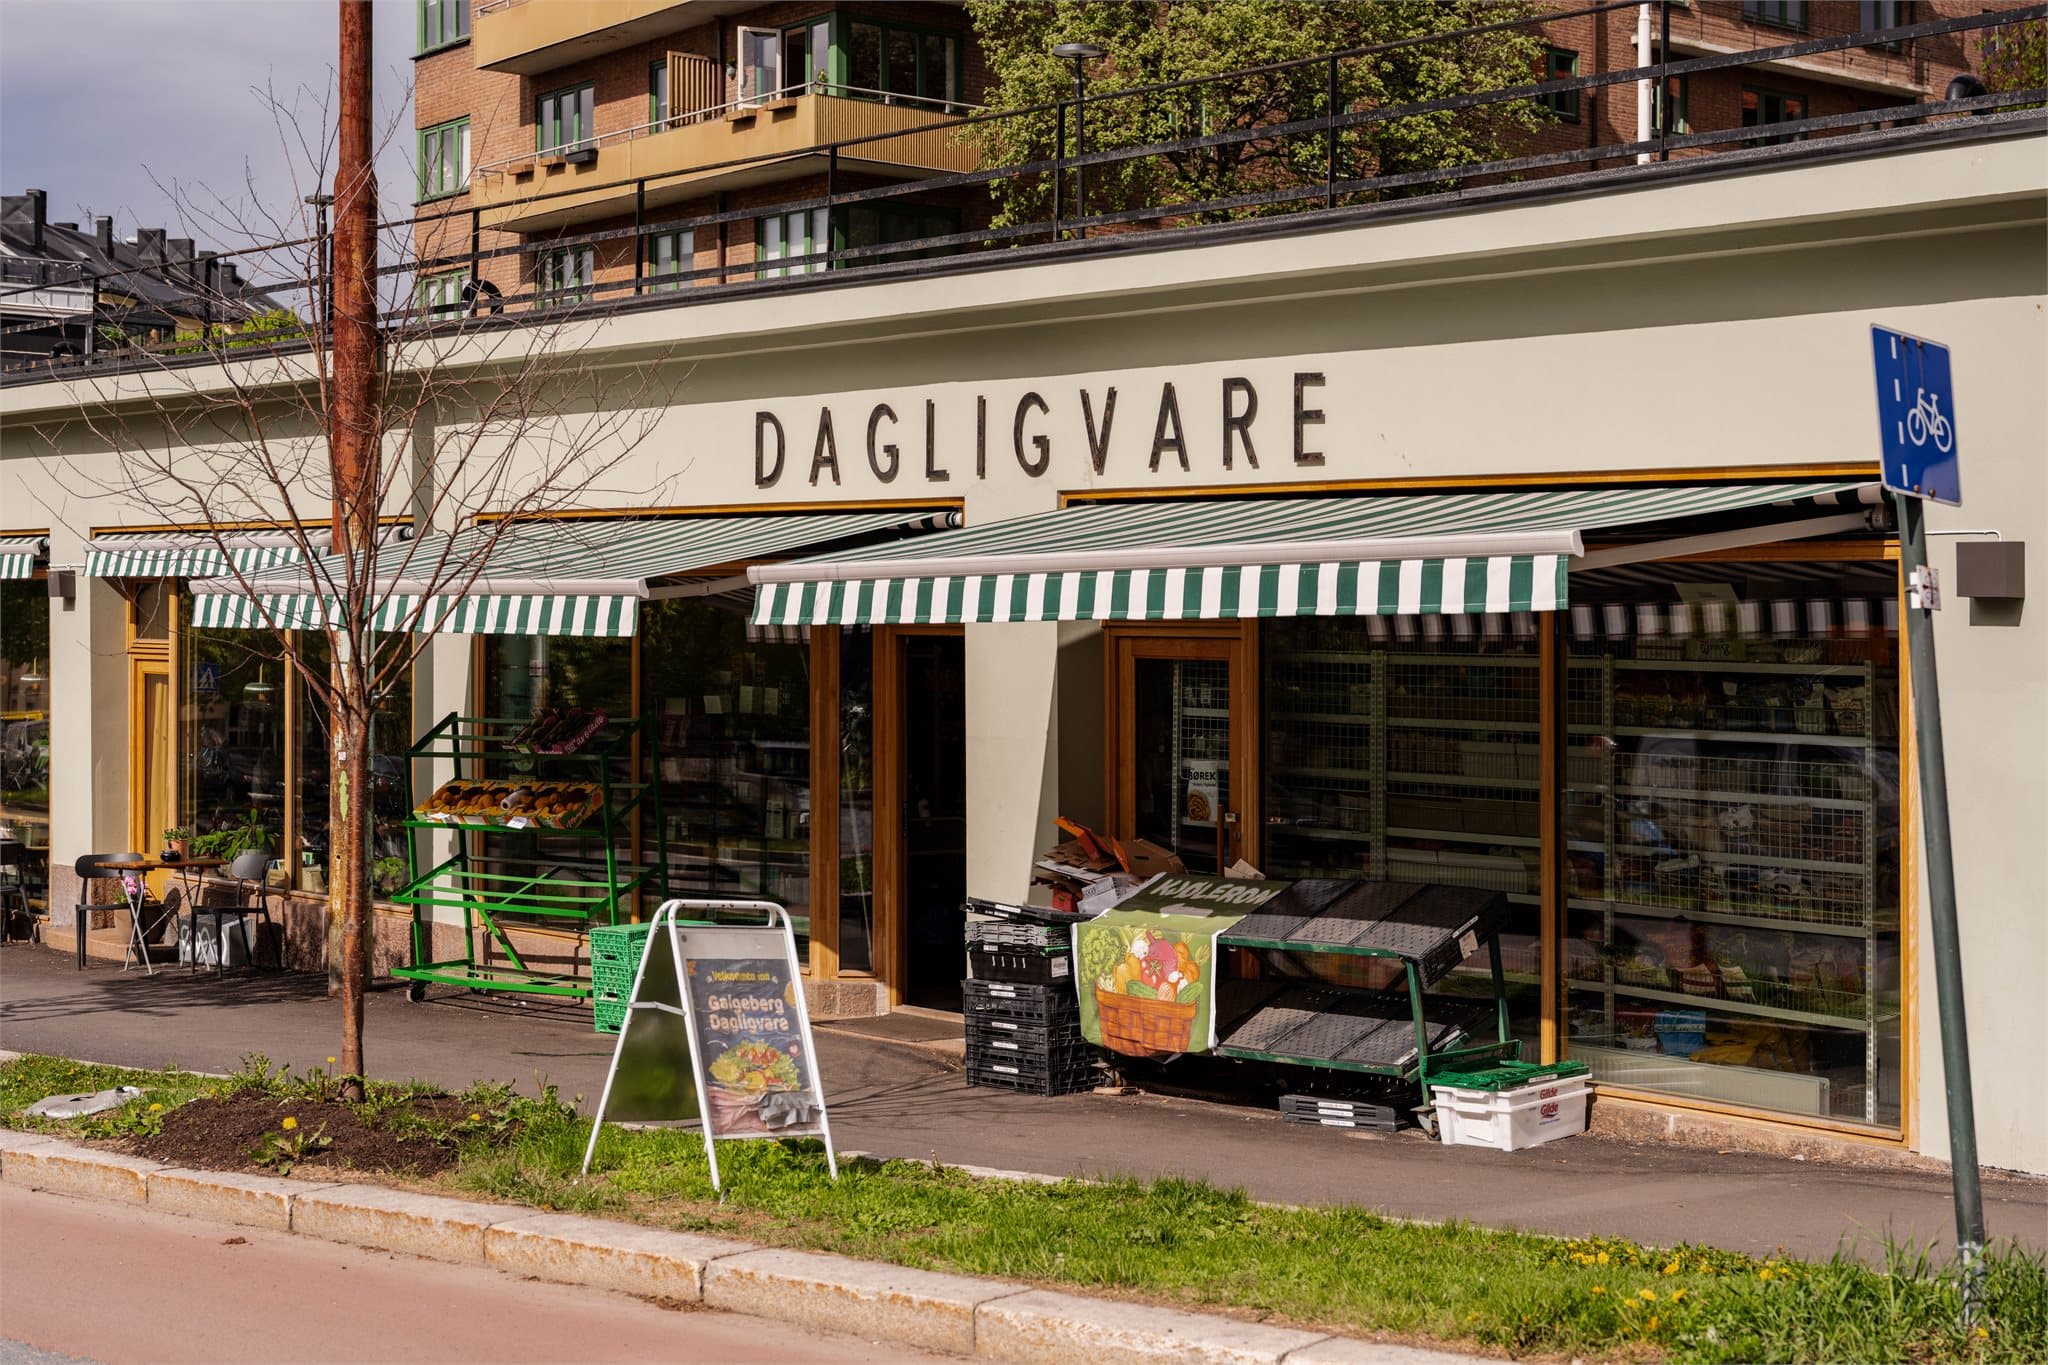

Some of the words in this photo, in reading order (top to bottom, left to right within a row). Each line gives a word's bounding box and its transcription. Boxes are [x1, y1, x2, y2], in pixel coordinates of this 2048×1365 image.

[755, 372, 1326, 487] DAGLIGVARE
[708, 994, 784, 1014] Galgeberg
[709, 1013, 789, 1034] Dagligvare
